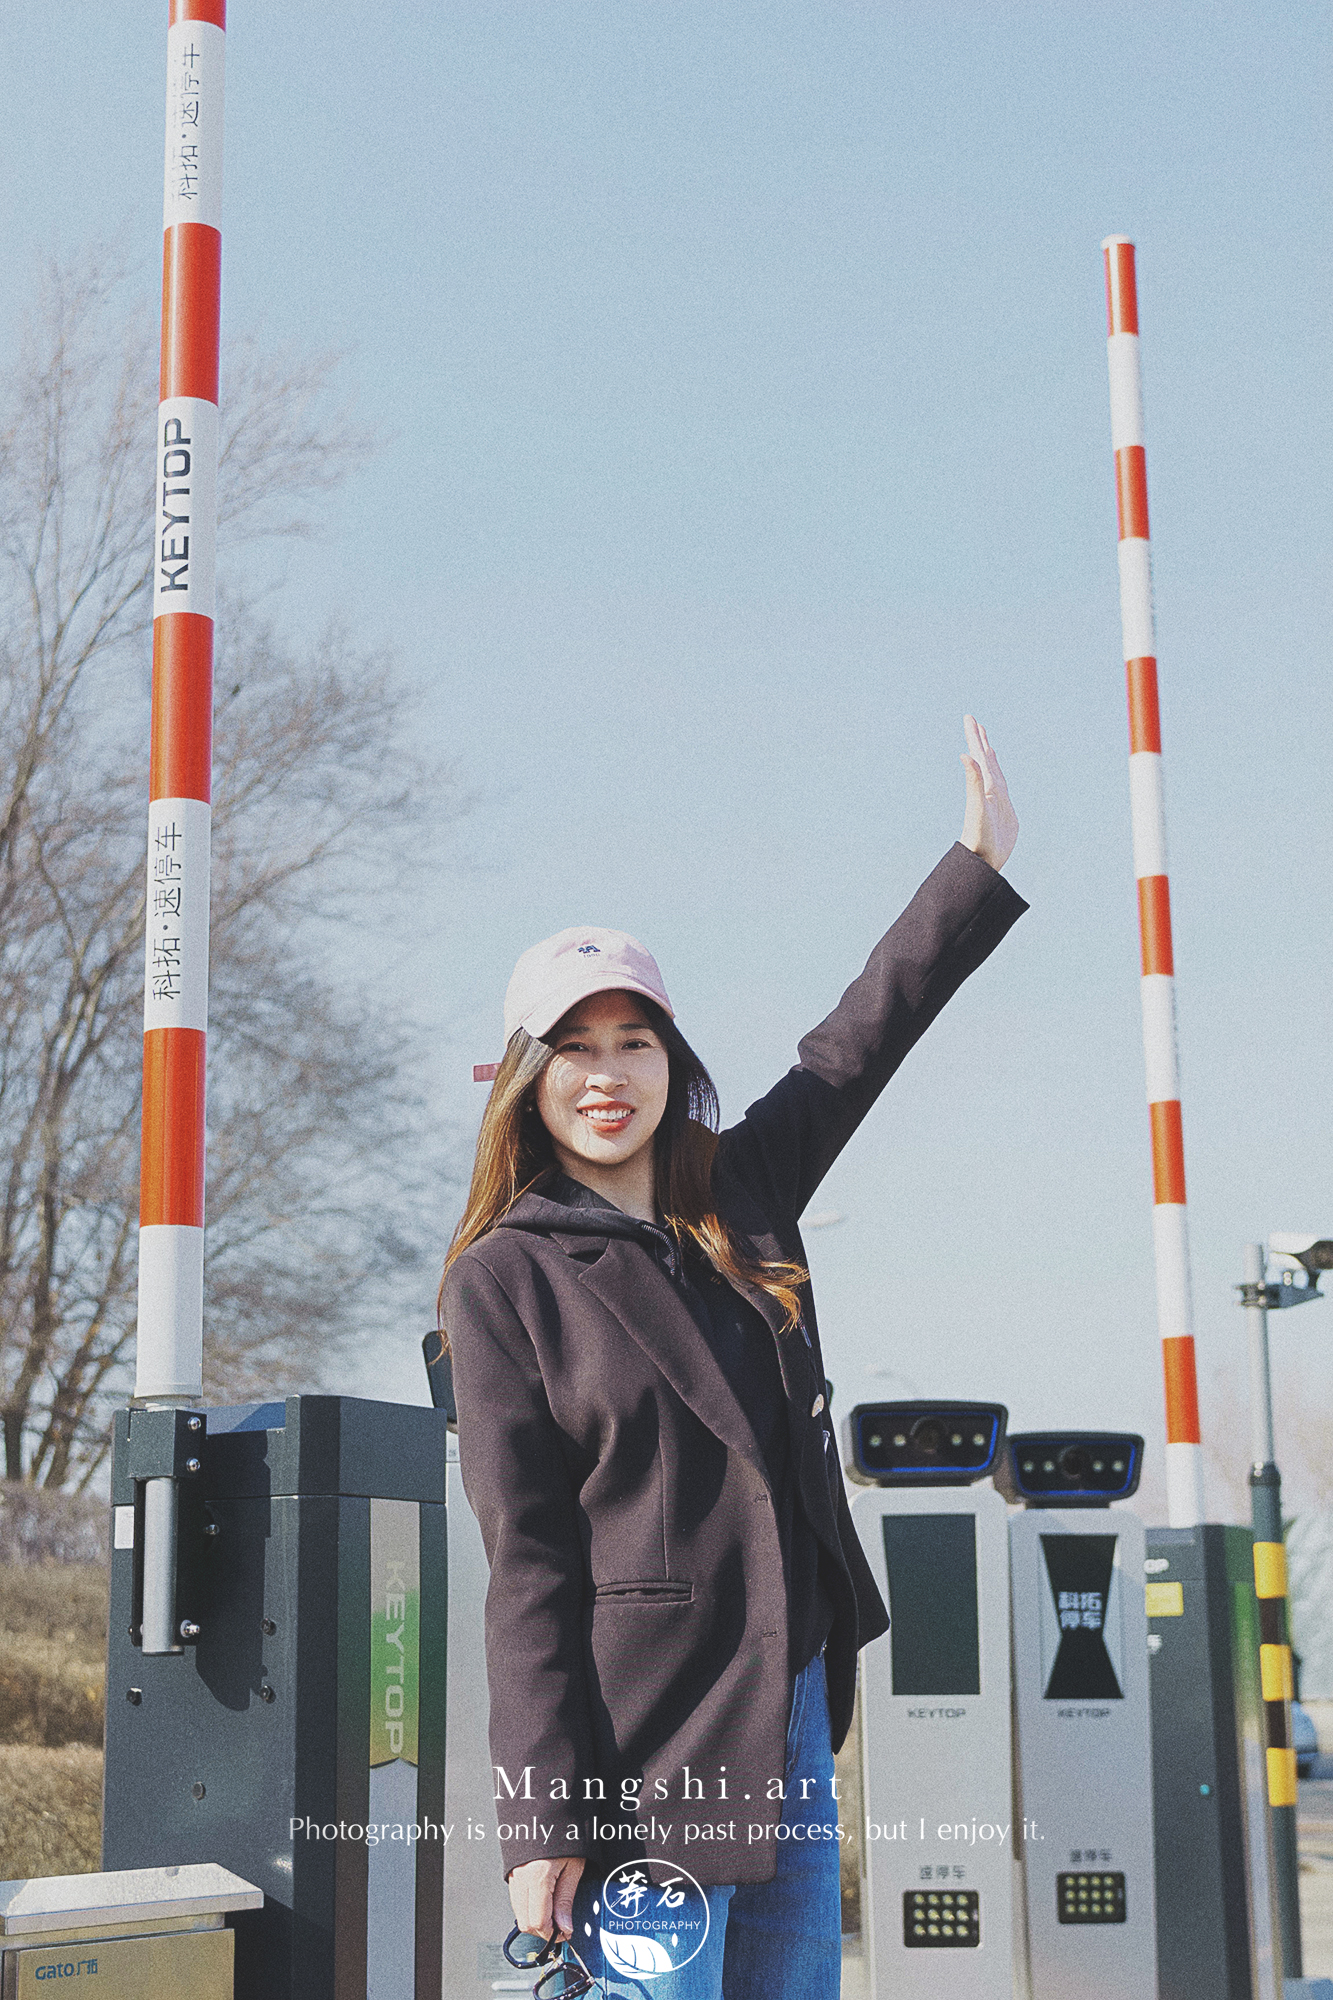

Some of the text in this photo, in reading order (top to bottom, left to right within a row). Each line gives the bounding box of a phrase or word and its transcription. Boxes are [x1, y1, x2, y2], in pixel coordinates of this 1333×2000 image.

[160, 417, 192, 594] KEYTOP
[152, 821, 182, 1001] 科拓·速停车
[385, 1560, 406, 1755] KEYTOP
[907, 1707, 966, 1719] KEYTOP
[1057, 1707, 1110, 1718] KEYTOP
